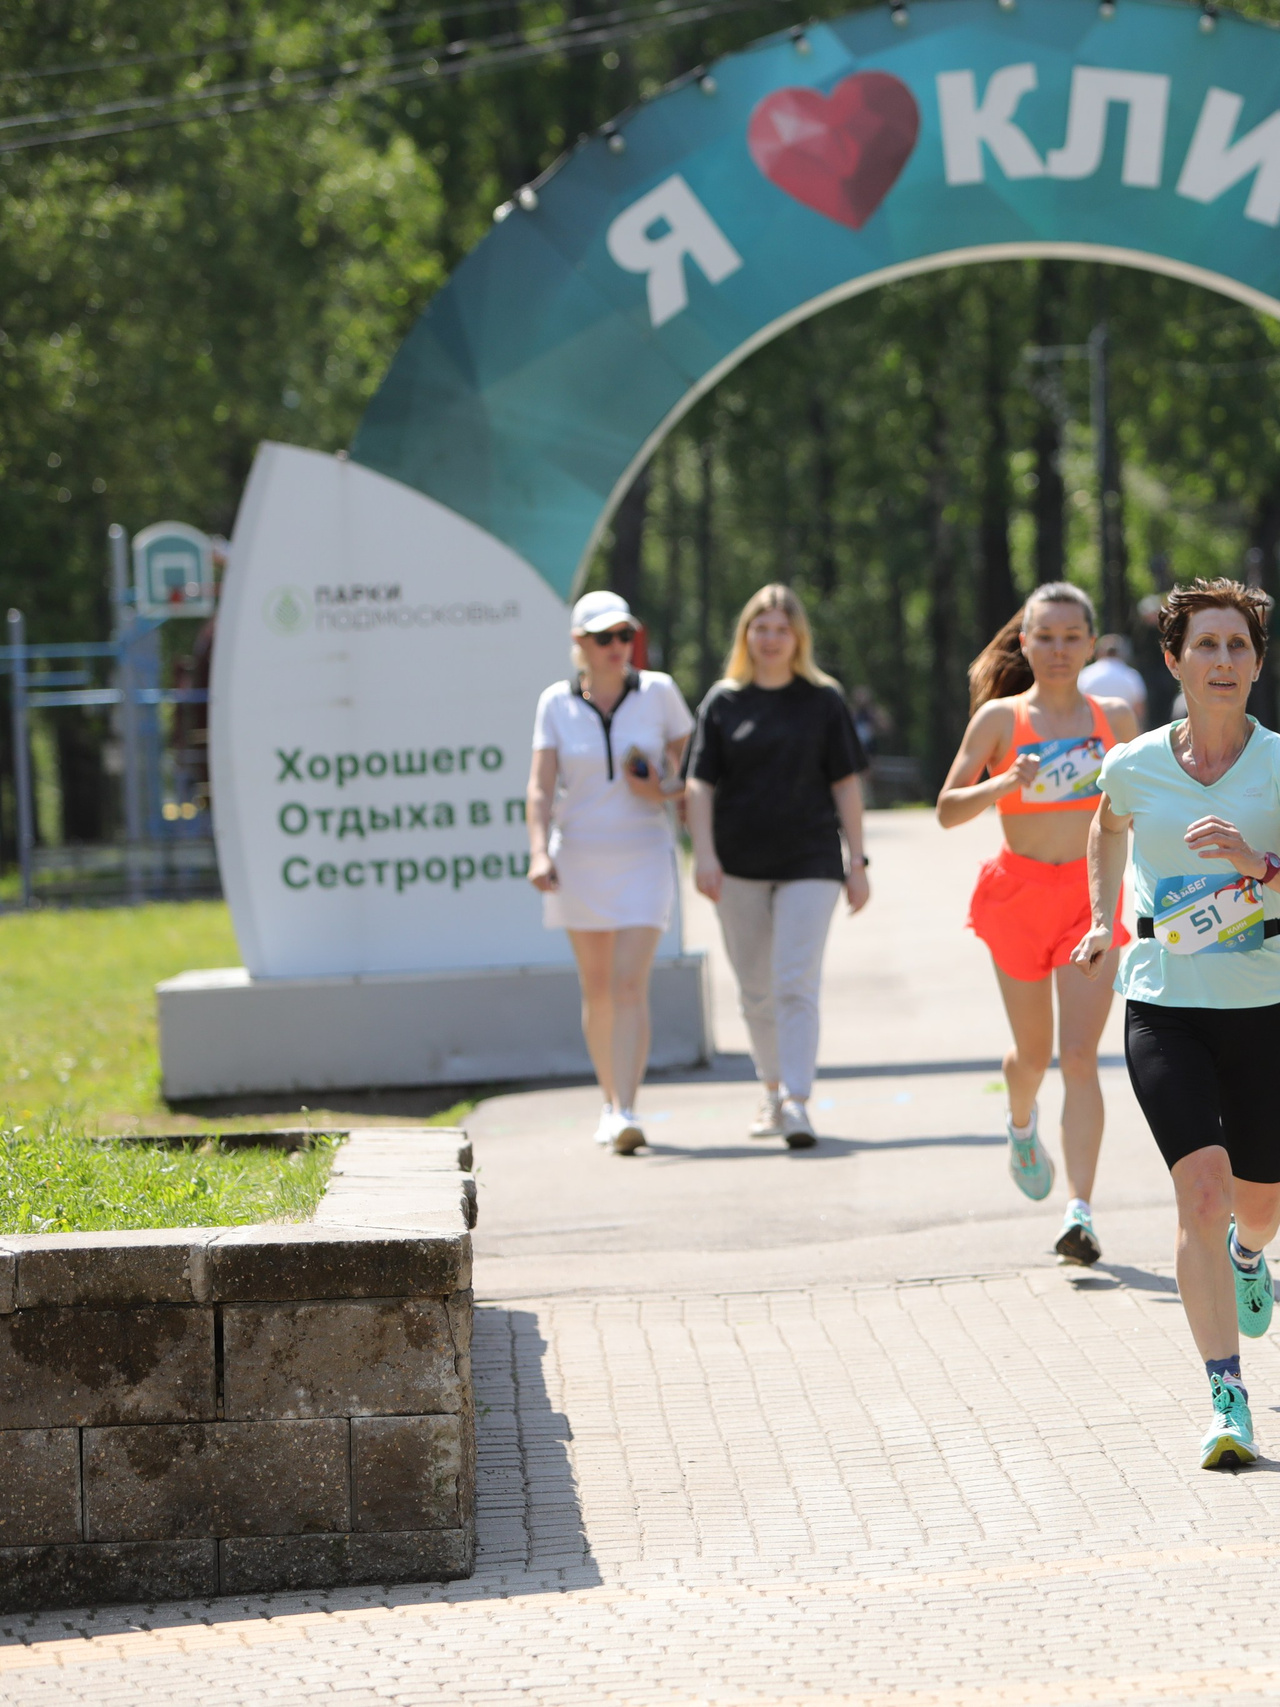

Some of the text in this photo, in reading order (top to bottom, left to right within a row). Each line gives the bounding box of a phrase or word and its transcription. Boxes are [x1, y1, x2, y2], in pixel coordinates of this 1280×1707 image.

[607, 173, 744, 328] Я
[314, 585, 402, 605] ПАРКИ
[276, 745, 504, 788] Хорошего
[1046, 761, 1079, 787] 72
[278, 801, 456, 839] Отдыха
[468, 799, 491, 827] в
[281, 852, 530, 893] Сестрорец
[1190, 904, 1222, 935] 51
